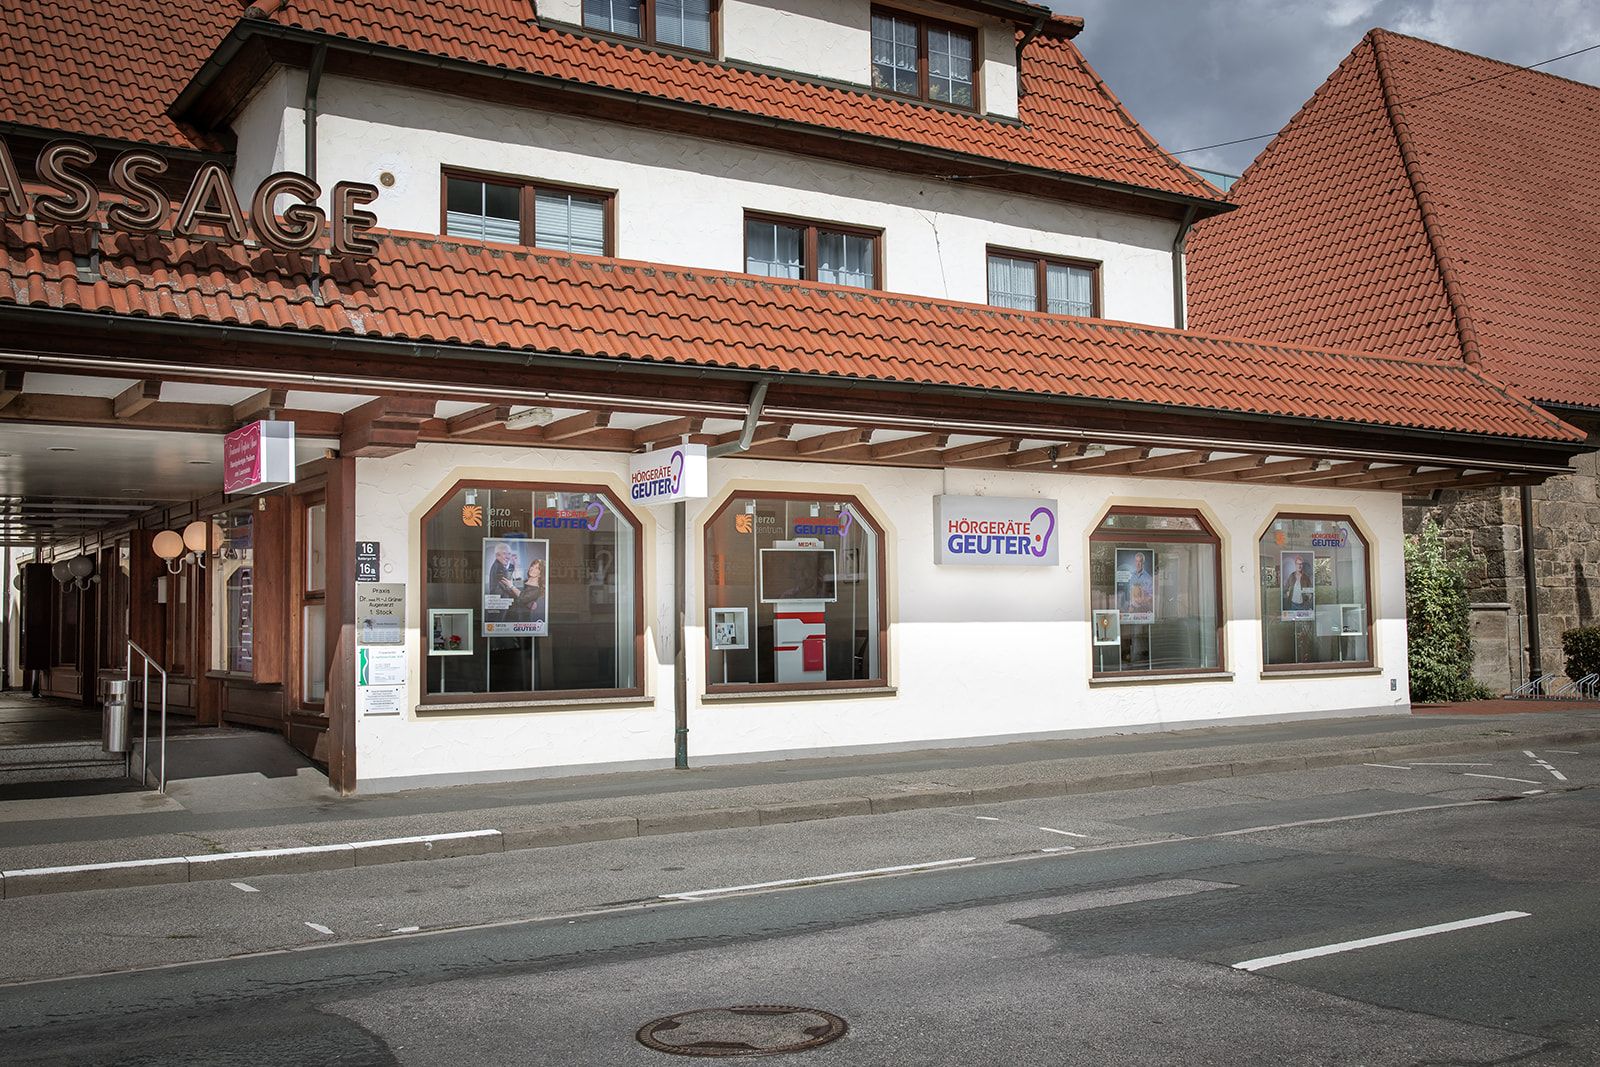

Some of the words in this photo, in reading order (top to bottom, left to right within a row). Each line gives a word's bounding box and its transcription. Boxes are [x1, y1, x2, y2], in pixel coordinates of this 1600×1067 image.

[631, 465, 672, 484] HÖRGERÄTE
[631, 477, 672, 500] GEUTER
[533, 516, 588, 529] GEUTER
[948, 517, 1031, 536] HÖRGERÄTE
[794, 525, 839, 536] GEUTER
[361, 543, 374, 554] 16
[947, 534, 1032, 555] GEUTER
[1312, 538, 1340, 547] GEUTER
[360, 563, 376, 575] 16a
